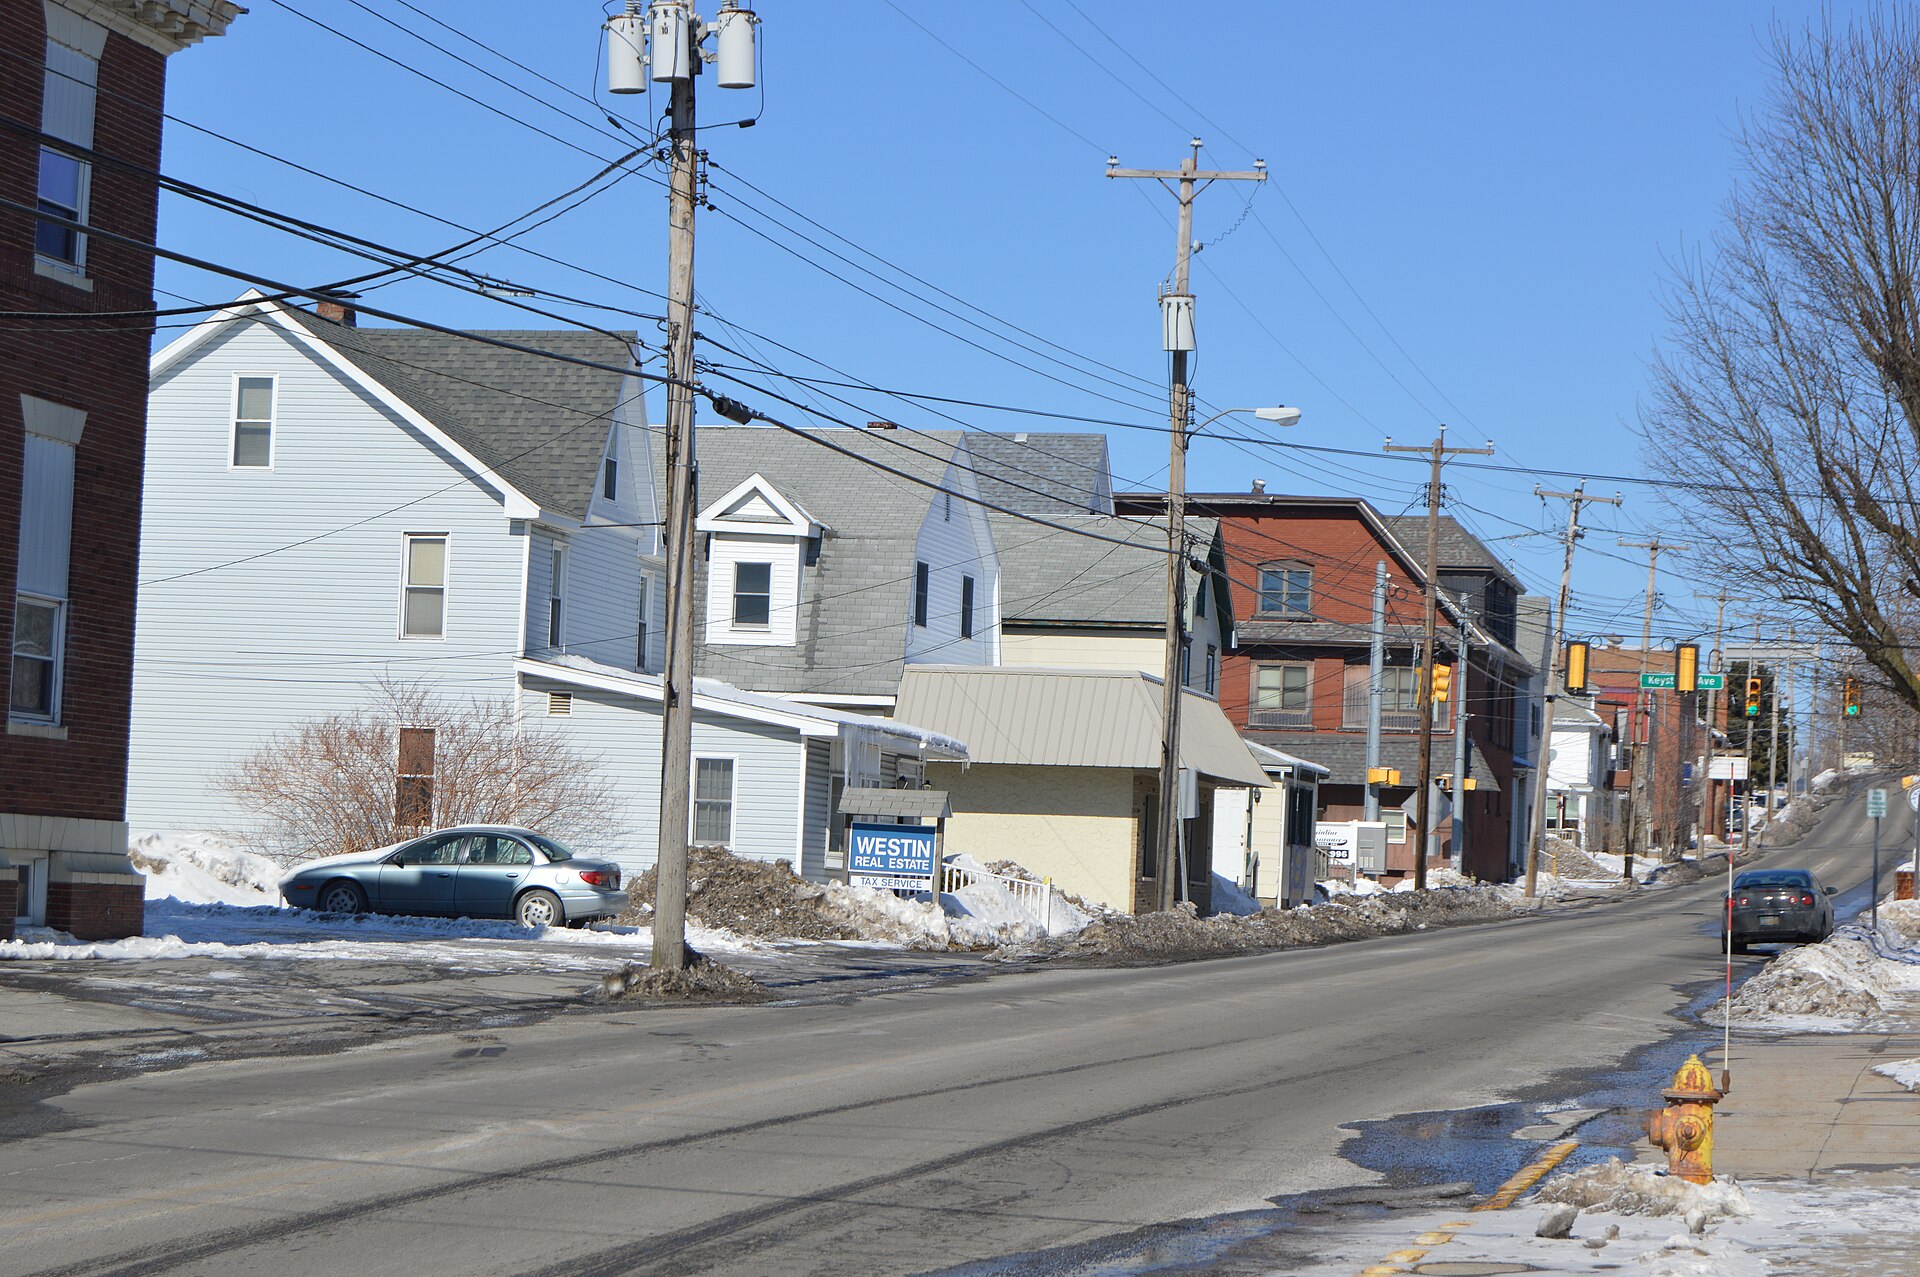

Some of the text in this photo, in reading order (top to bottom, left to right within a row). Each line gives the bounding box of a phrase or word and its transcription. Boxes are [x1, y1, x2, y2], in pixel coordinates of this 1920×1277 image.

[1647, 675, 1716, 687] Keyst Ave
[856, 836, 931, 858] WESTIN
[855, 856, 930, 871] REAL ESTATE
[860, 877, 923, 889] TAX SERVICE
